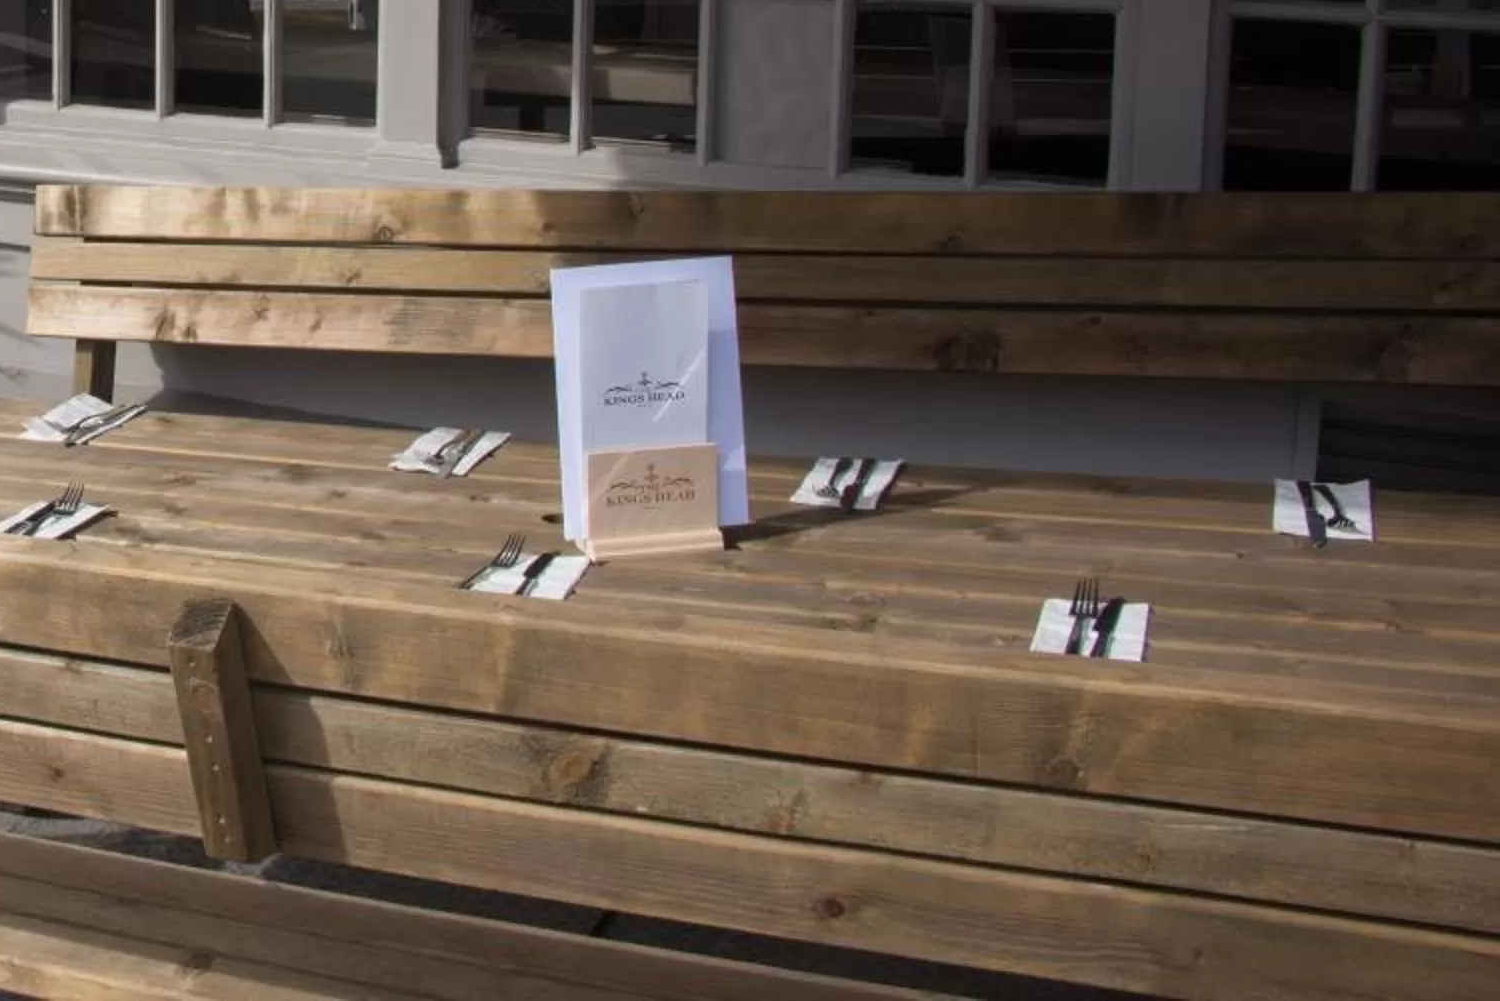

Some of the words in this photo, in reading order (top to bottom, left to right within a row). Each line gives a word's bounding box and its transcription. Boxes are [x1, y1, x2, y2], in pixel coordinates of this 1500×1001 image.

[603, 394, 645, 406] KINGS
[648, 390, 686, 403] HEAD
[605, 494, 652, 508] KINGS
[655, 488, 696, 504] HEAD
